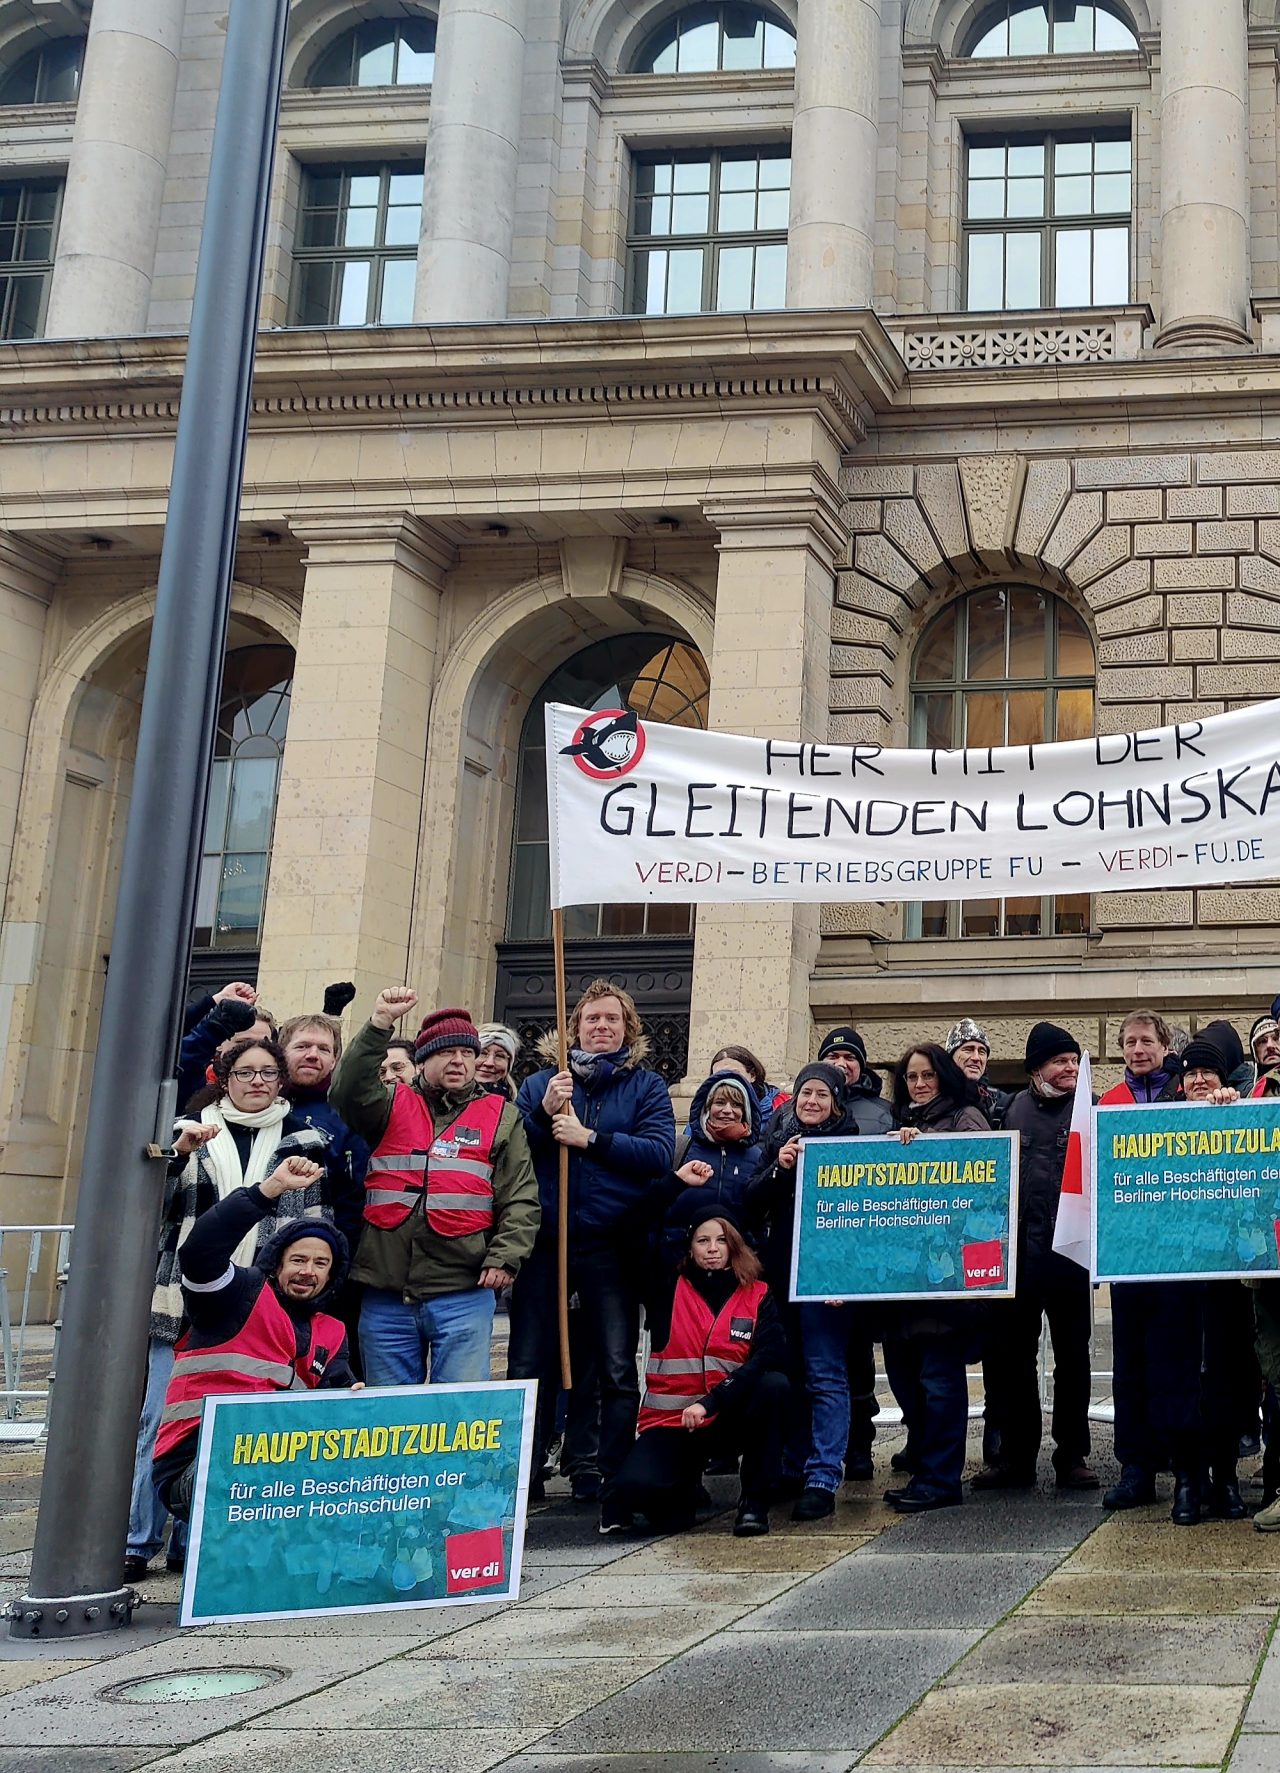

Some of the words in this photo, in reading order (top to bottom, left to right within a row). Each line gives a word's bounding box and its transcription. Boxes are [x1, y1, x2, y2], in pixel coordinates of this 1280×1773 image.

[765, 739, 884, 776] HER
[1095, 722, 1206, 765] DER
[599, 782, 988, 838] GLEITENDEN
[1010, 856, 1043, 878] FU
[1098, 838, 1265, 873] VERDI-FU.DE
[817, 1160, 996, 1188] HAUPTSTADTZULAGE
[1114, 1173, 1131, 1186] für
[1136, 1172, 1159, 1185] alle
[1164, 1168, 1256, 1185] Beschäftigten
[817, 1200, 833, 1213] für
[837, 1199, 859, 1212] alle
[863, 1198, 948, 1212] Beschäftigten
[952, 1197, 973, 1209] der
[1114, 1190, 1166, 1203] Berliner
[1170, 1186, 1260, 1201] Hochschulen
[816, 1216, 865, 1229] Berliner
[869, 1213, 951, 1227] Hochschulen
[232, 1419, 502, 1465] HAUPTSTADTZULAGE
[230, 1482, 256, 1500] für
[261, 1480, 295, 1497] alle
[301, 1475, 430, 1498] Beschäftigten
[435, 1470, 466, 1487] der
[228, 1504, 304, 1522] Berliner
[308, 1493, 431, 1517] Hochschulen
